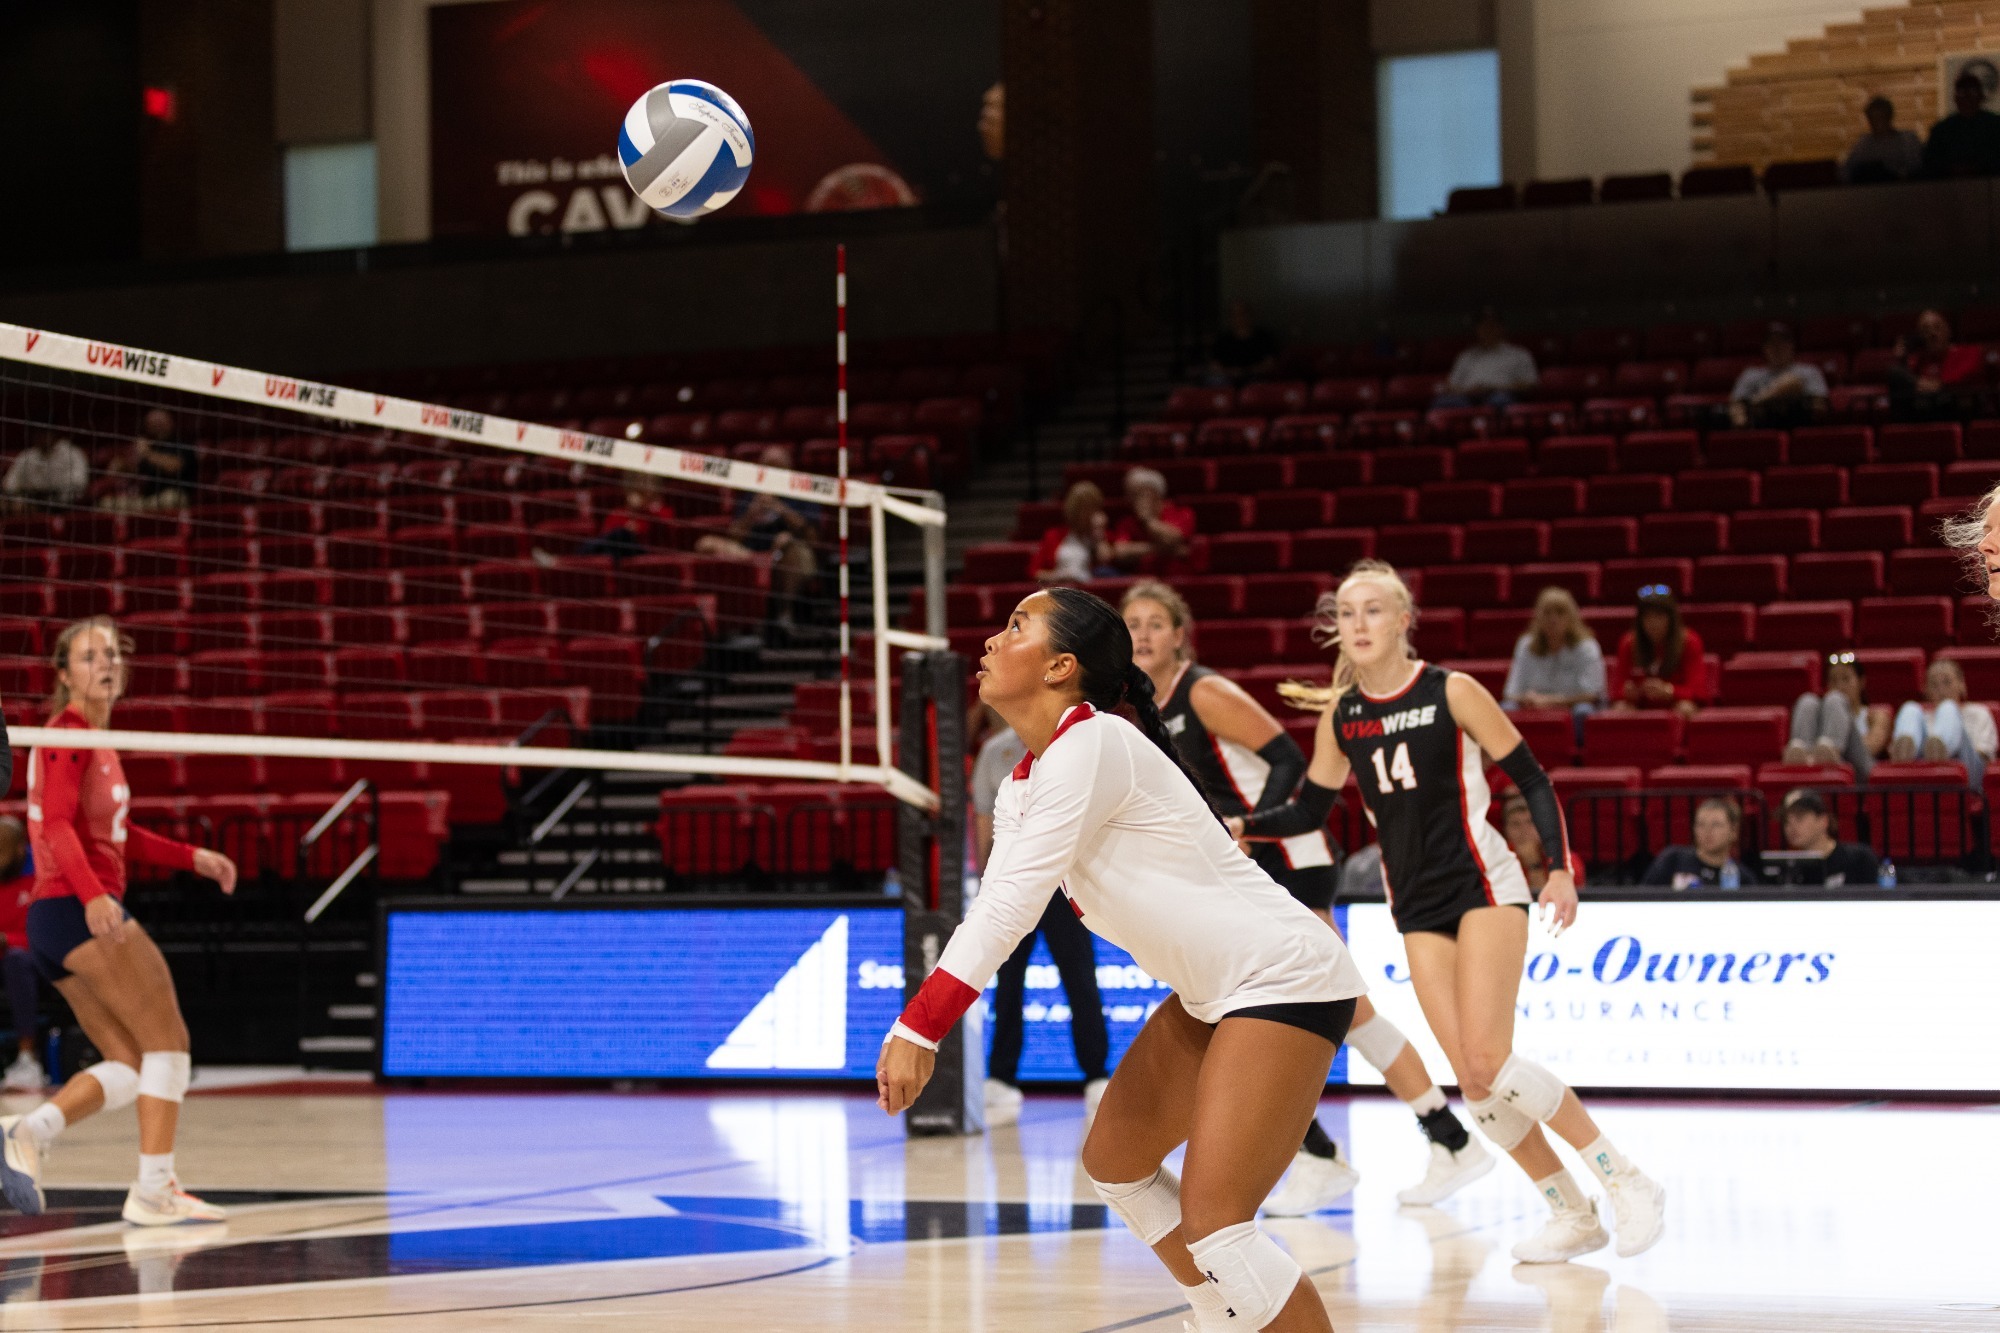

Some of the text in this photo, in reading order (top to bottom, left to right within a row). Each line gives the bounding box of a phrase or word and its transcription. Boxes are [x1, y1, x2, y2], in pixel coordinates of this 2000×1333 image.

[507, 186, 672, 238] CAV
[87, 343, 170, 378] UVAWISE
[265, 378, 338, 408] UVAWISE
[421, 407, 485, 435] UVAWISE
[1341, 704, 1437, 741] UVAWISE
[1371, 742, 1418, 794] 14
[1384, 935, 1836, 984] o-Owners
[1515, 1000, 1736, 1021] NSURANCE
